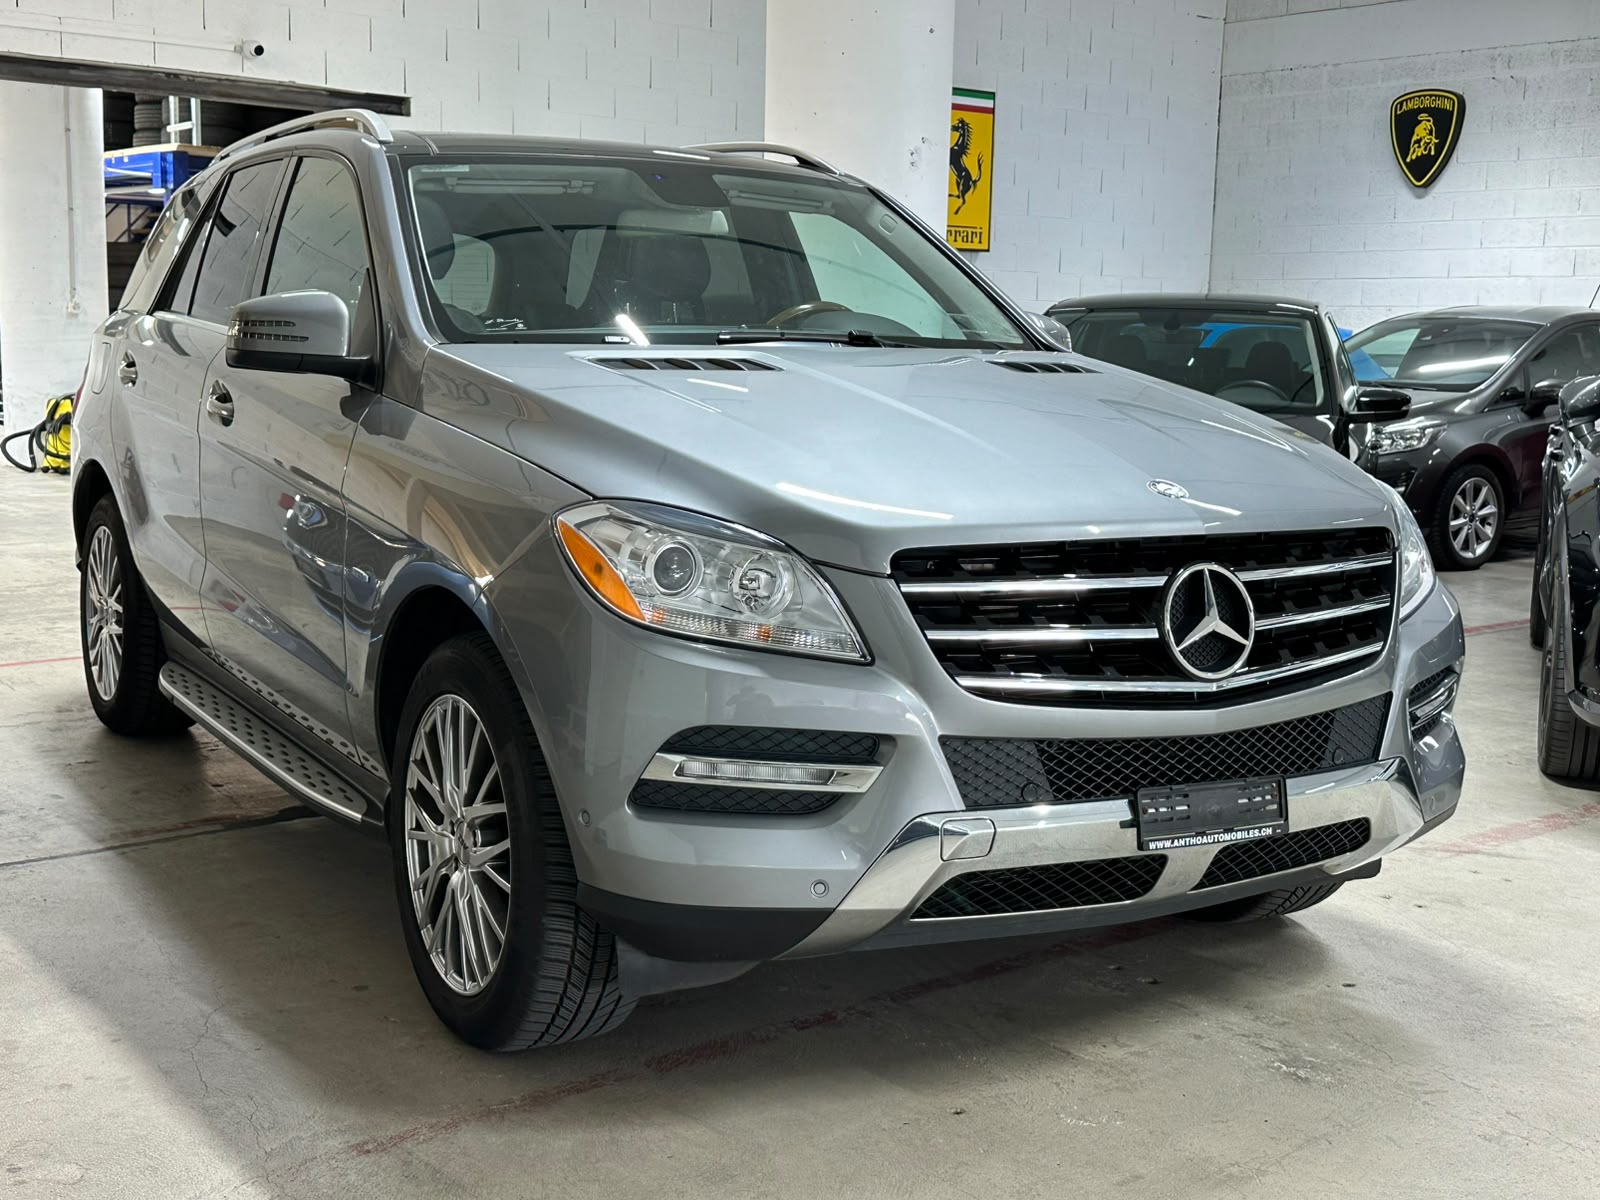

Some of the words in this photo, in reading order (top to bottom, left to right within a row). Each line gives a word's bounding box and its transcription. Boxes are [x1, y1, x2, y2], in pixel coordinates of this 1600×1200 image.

[1397, 96, 1453, 115] LAMBORGHINI
[947, 226, 983, 244] rrari
[1149, 827, 1273, 850] WWW.ANTHOAUTOMOBILES.CH
